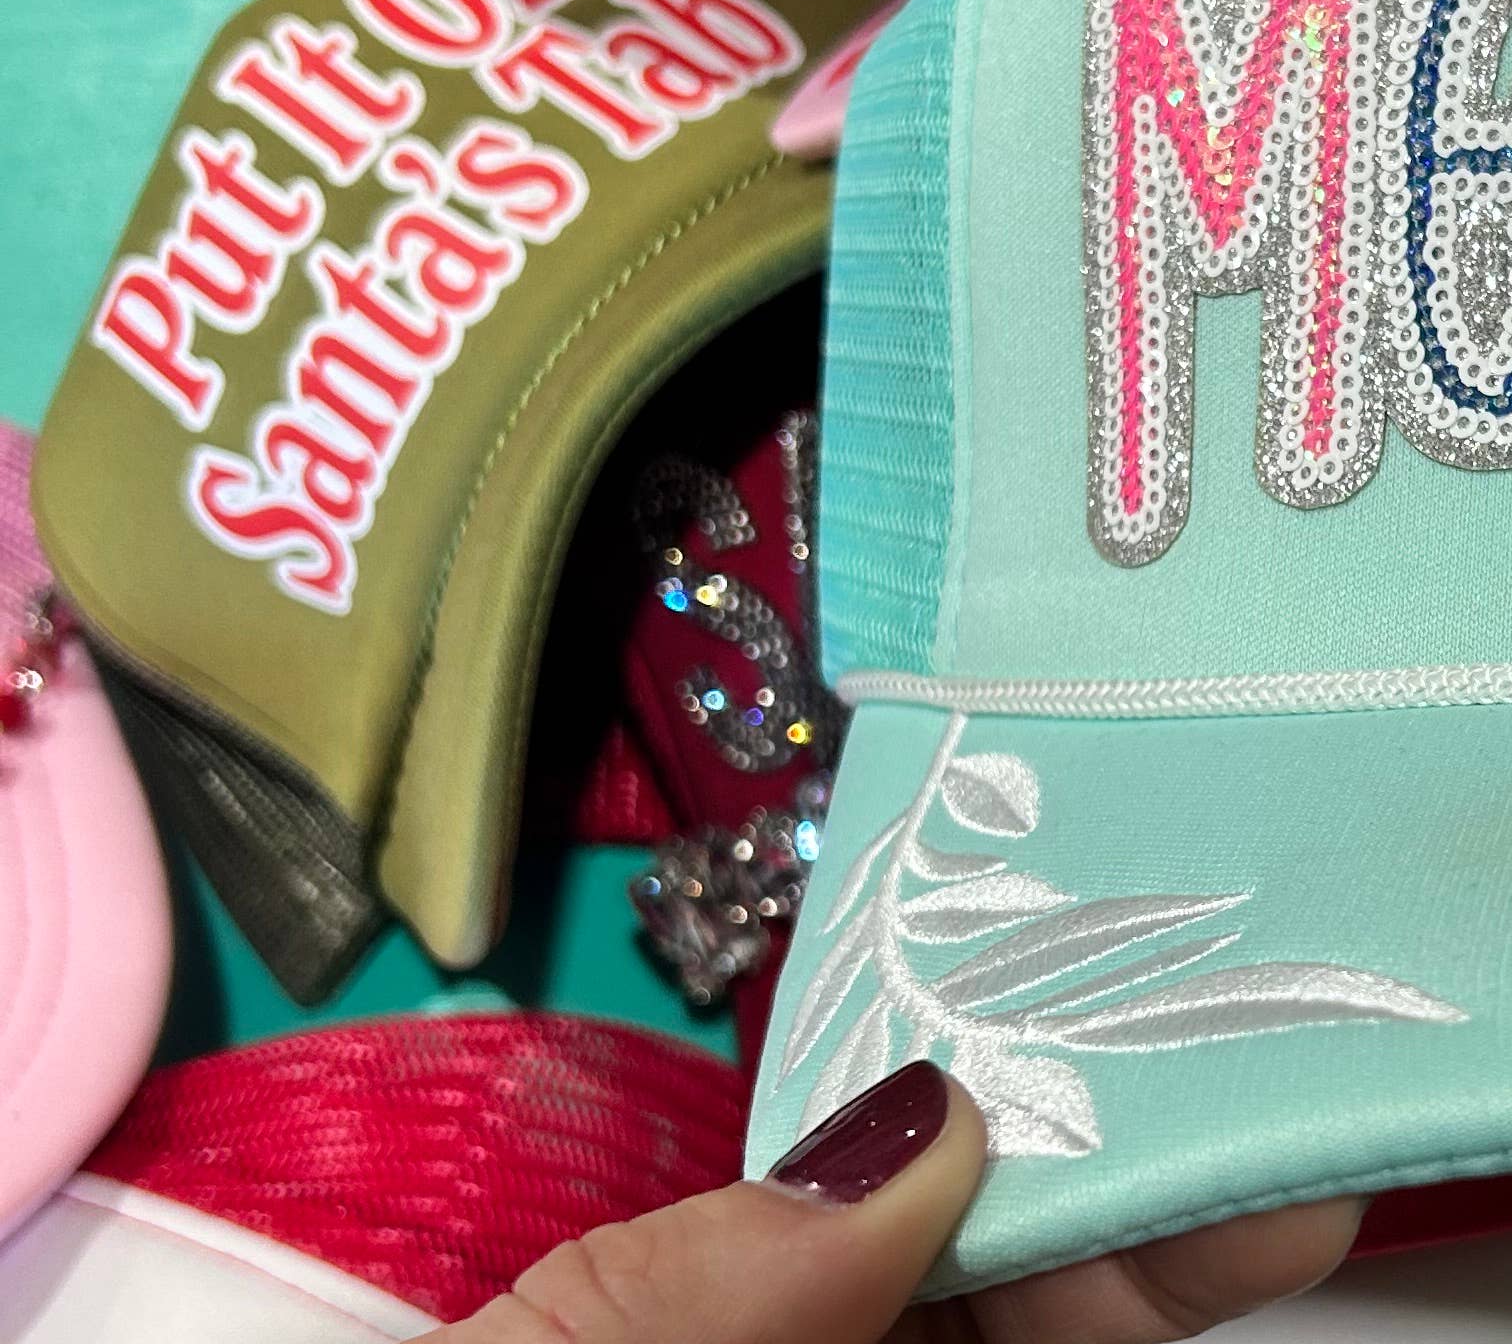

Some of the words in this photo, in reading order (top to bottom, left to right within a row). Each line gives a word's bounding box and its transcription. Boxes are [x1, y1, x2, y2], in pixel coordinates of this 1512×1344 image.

[96, 126, 322, 427] Put
[216, 15, 422, 183] It
[187, 122, 587, 615] Santa's
